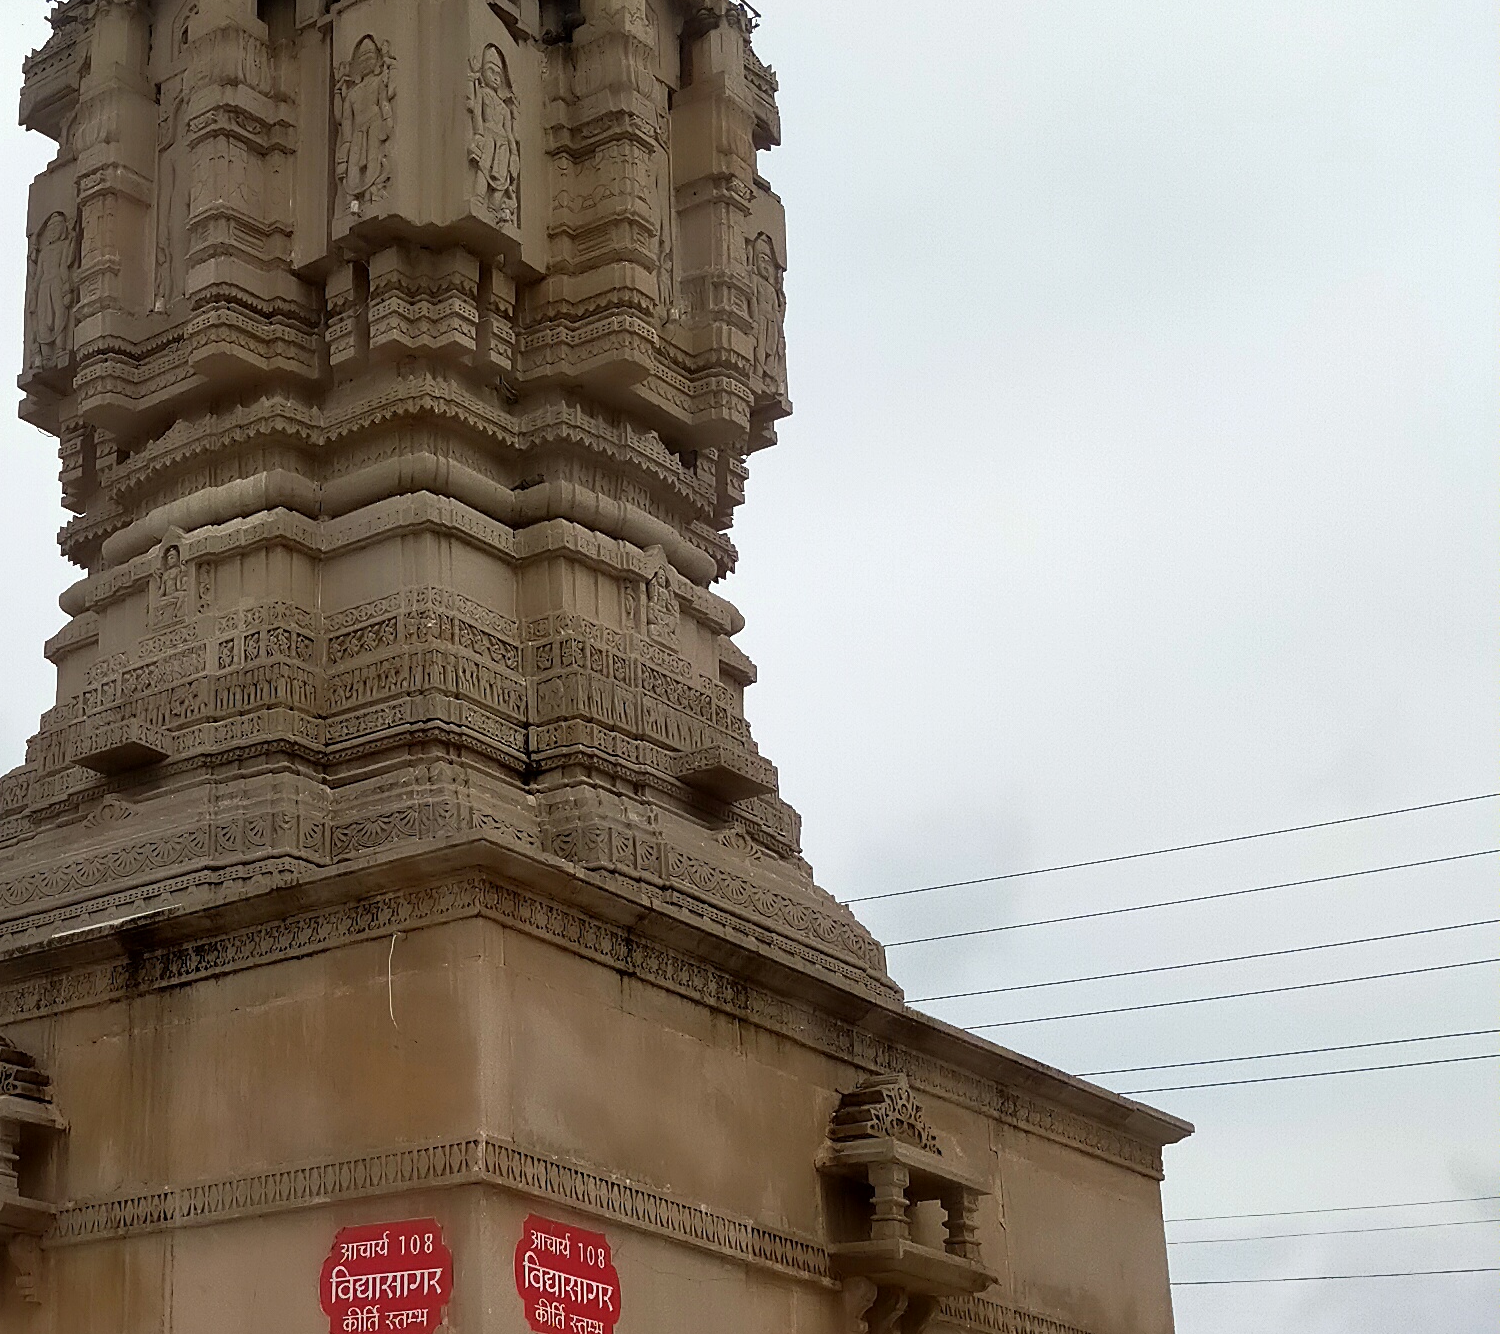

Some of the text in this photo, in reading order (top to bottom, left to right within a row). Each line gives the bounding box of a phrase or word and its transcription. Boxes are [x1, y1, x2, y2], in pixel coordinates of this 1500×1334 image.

[340, 1230, 433, 1263] आचार्य 108
[530, 1229, 605, 1269] आचार्य 108
[330, 1266, 443, 1303] विद्यासागर
[522, 1250, 613, 1312] विद्यासागर
[343, 1305, 428, 1332] कीर्ति स्तम्भ
[534, 1298, 566, 1330] कीर्ति
